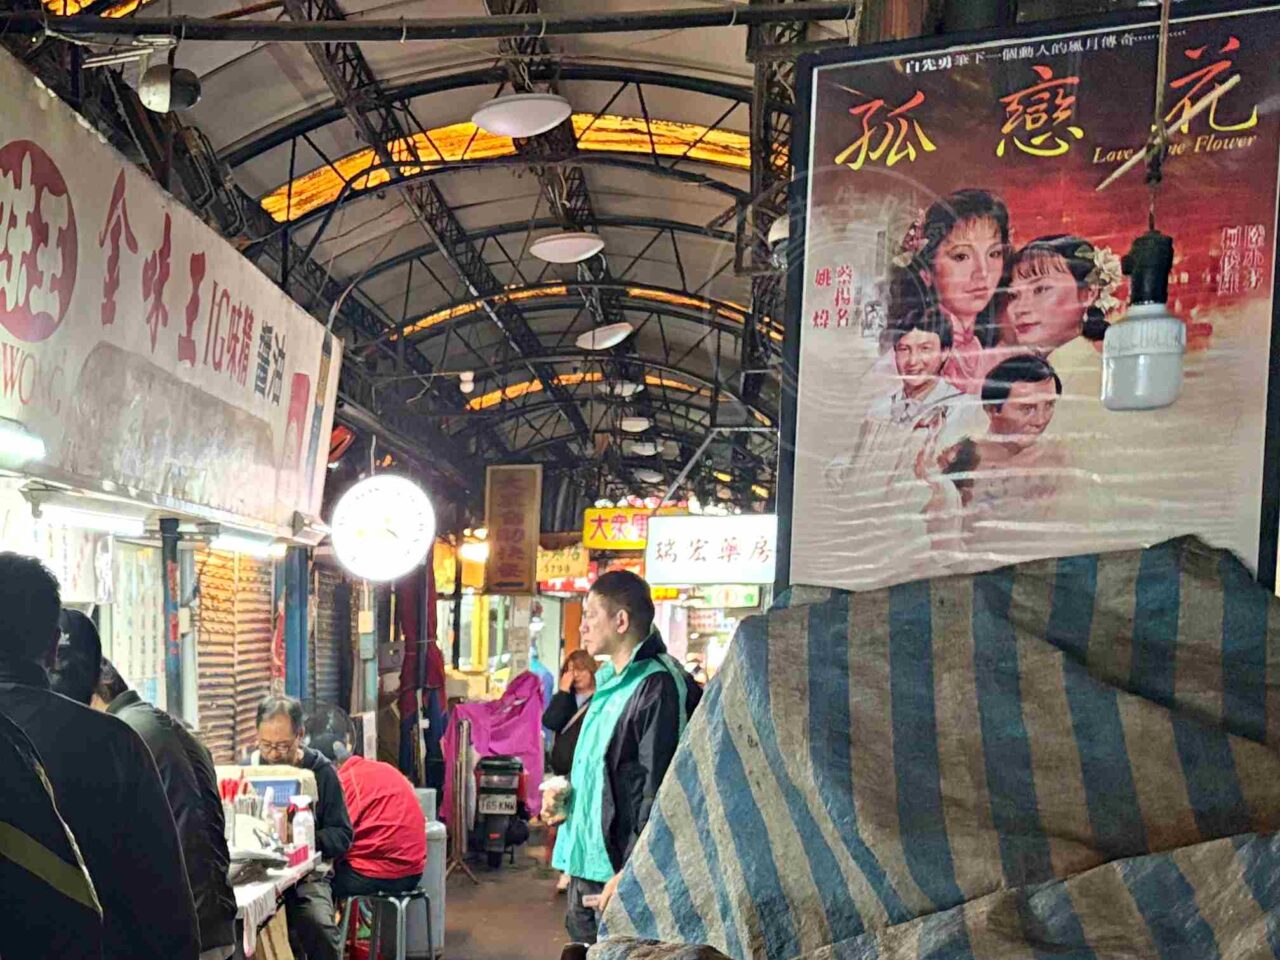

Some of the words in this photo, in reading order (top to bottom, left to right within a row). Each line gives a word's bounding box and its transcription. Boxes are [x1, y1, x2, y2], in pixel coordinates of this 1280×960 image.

[835, 36, 1259, 171] 孤戀花
[1093, 147, 1133, 164] Love
[1194, 134, 1258, 153] Flower
